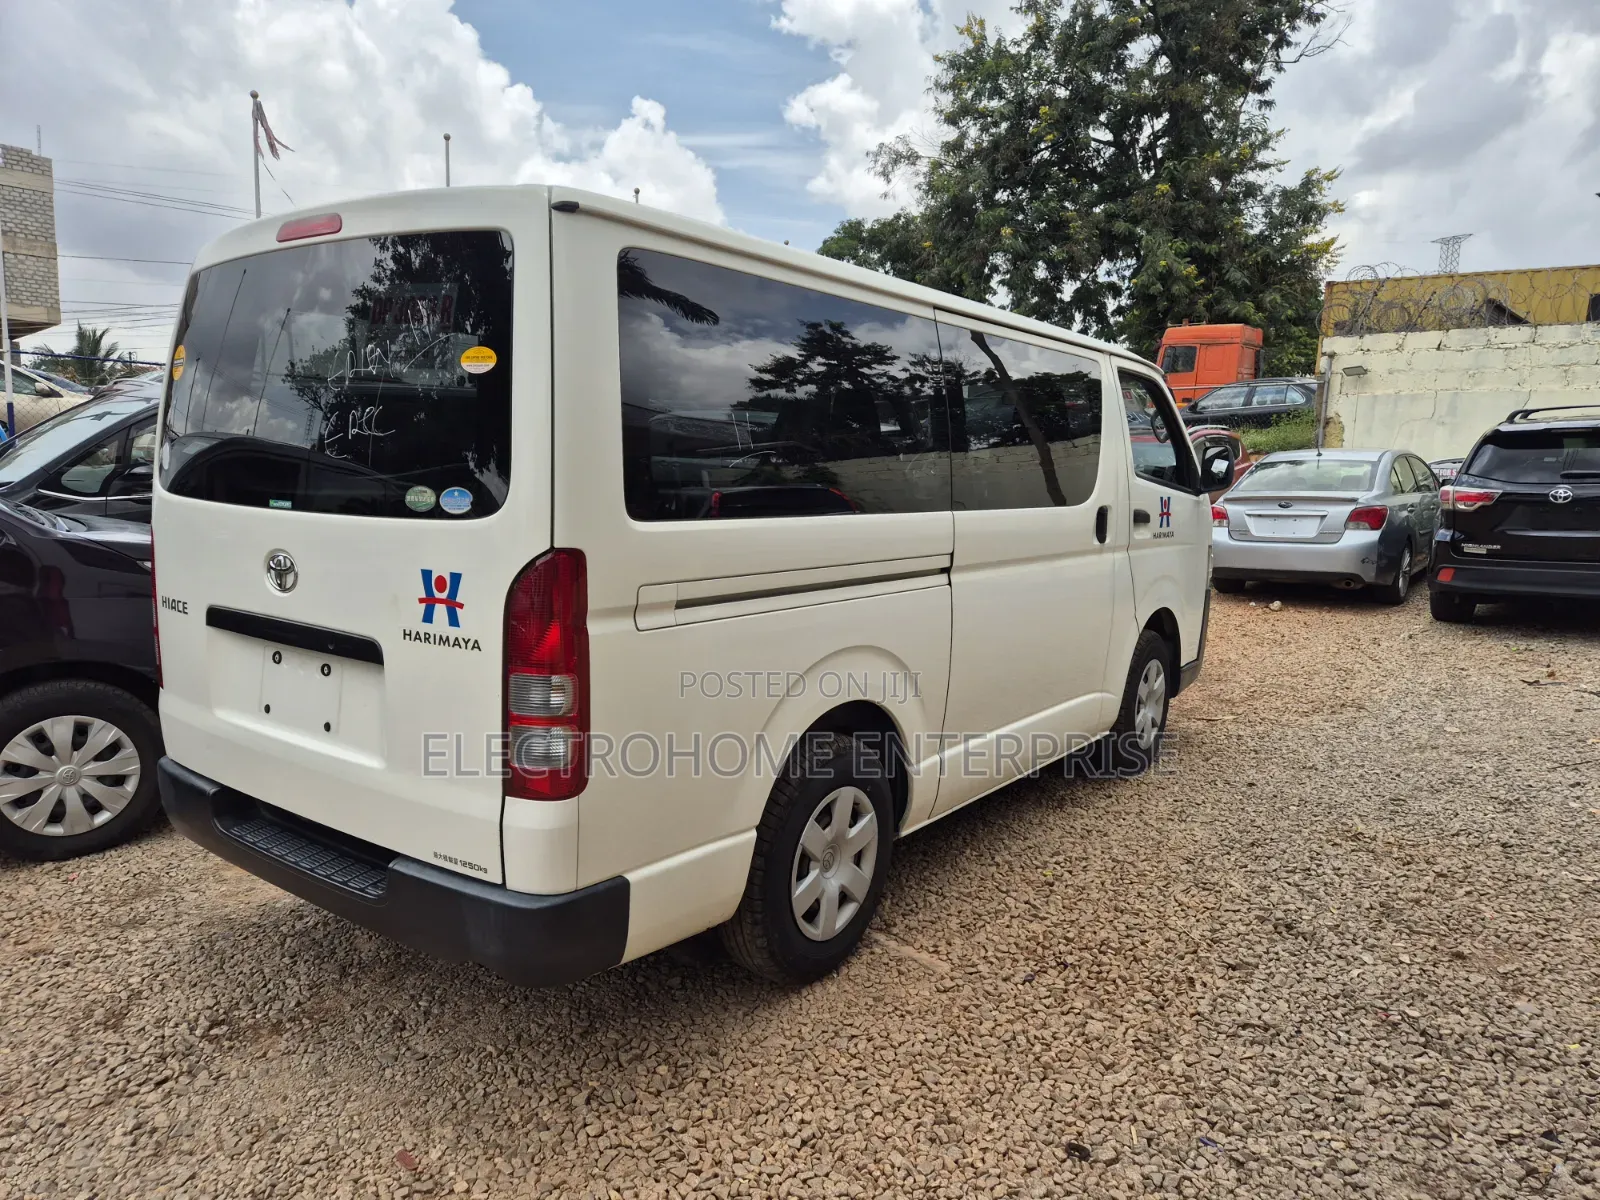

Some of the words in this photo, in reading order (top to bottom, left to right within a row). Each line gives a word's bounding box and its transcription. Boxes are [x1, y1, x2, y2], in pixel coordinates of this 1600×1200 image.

[161, 595, 189, 615] HIACE
[402, 628, 482, 652] HARIMAYA
[459, 859, 488, 874] 1250kg
